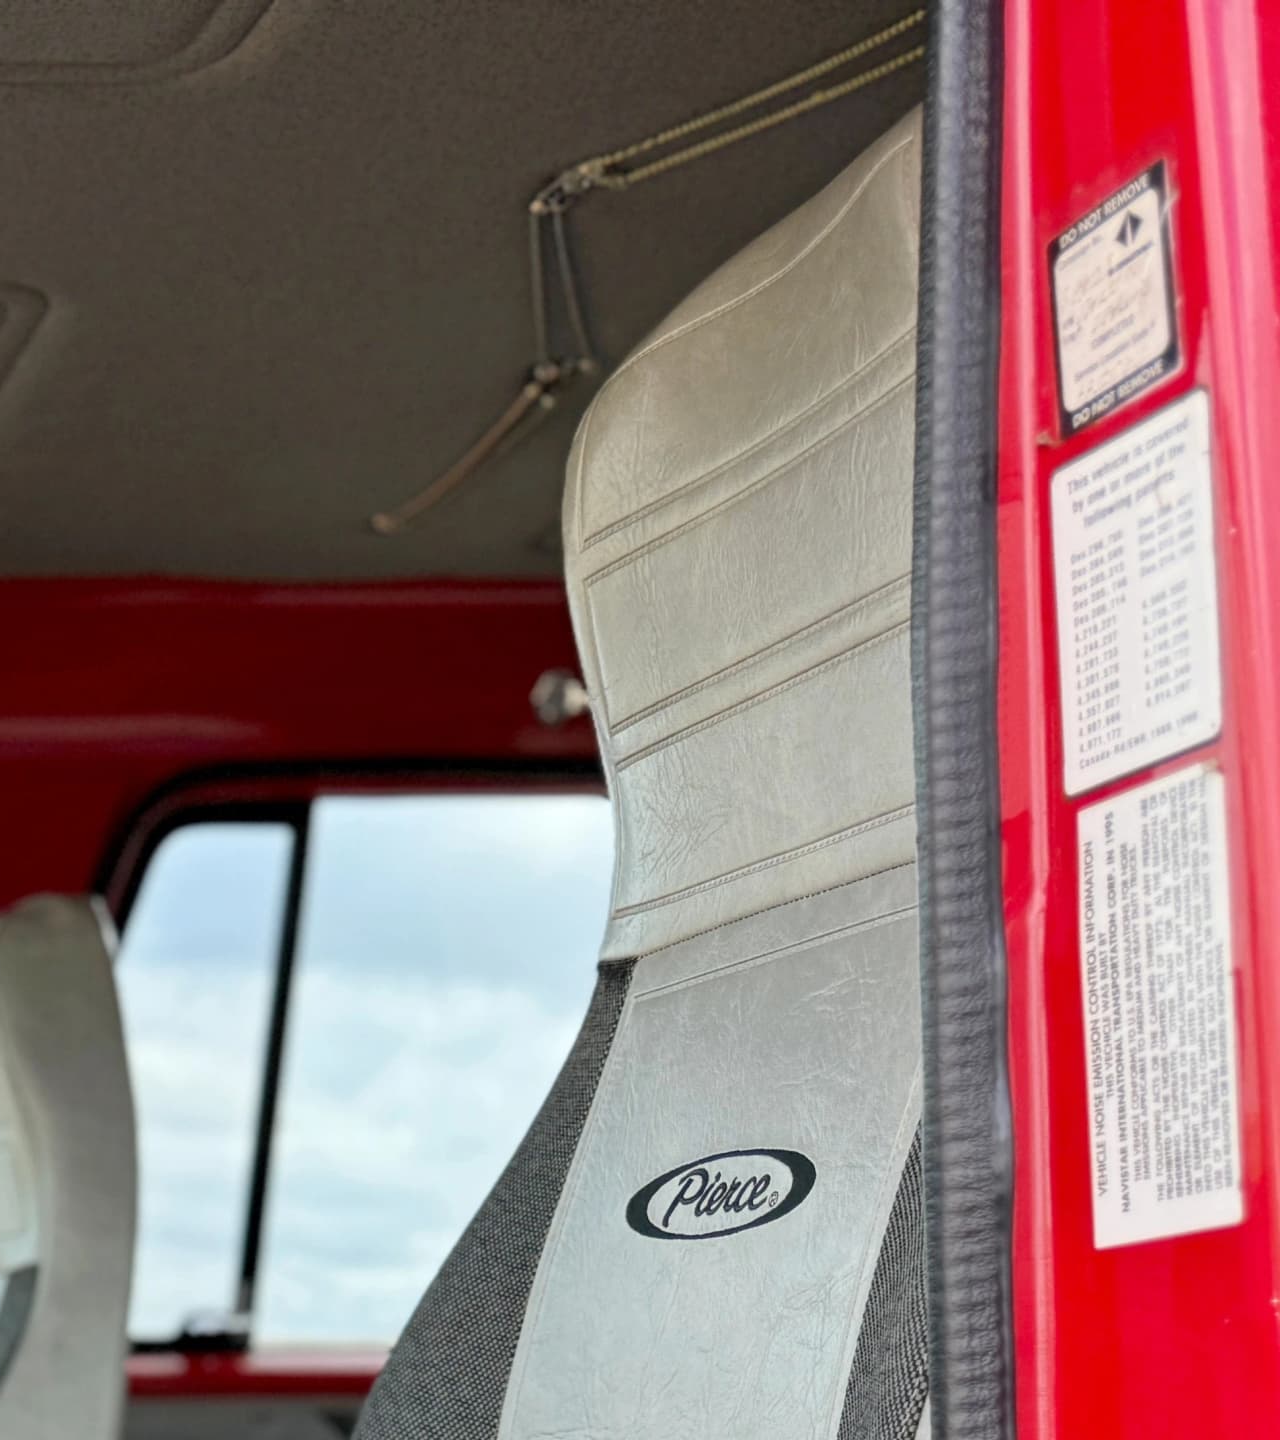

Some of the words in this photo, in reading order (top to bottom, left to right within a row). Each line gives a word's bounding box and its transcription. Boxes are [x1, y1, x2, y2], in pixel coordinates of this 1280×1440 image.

[1058, 225, 1077, 251] DO
[1077, 206, 1101, 237] NOT
[1104, 172, 1148, 217] REMOVE
[1067, 471, 1088, 496] This
[1092, 448, 1128, 480] vehicle
[1133, 443, 1142, 458] is
[1145, 415, 1188, 451] covered
[1072, 495, 1083, 516] by
[1087, 485, 1105, 505] one
[1124, 460, 1150, 485] more
[1169, 439, 1184, 460] the
[1083, 491, 1131, 532] following
[1106, 848, 1114, 865] IN
[1083, 840, 1096, 943] INFORMATION
[1107, 867, 1116, 909] CORP.
[1098, 930, 1106, 946] BY
[1099, 949, 1108, 980] BUILT
[1087, 945, 1099, 1015] CONTROL
[1101, 983, 1109, 1012] WAS
[1109, 911, 1121, 1032] TRANSPORTATION
[1090, 1017, 1102, 1088] EMISSION
[1093, 1091, 1104, 1136] NOISE
[1105, 1073, 1113, 1098] THIS
[1114, 1035, 1126, 1141] INTERNATIONAL
[662, 1168, 772, 1228] Pierce
[1096, 1140, 1107, 1196] VEHICLE
[1119, 1145, 1129, 1212] NAVISTAR
